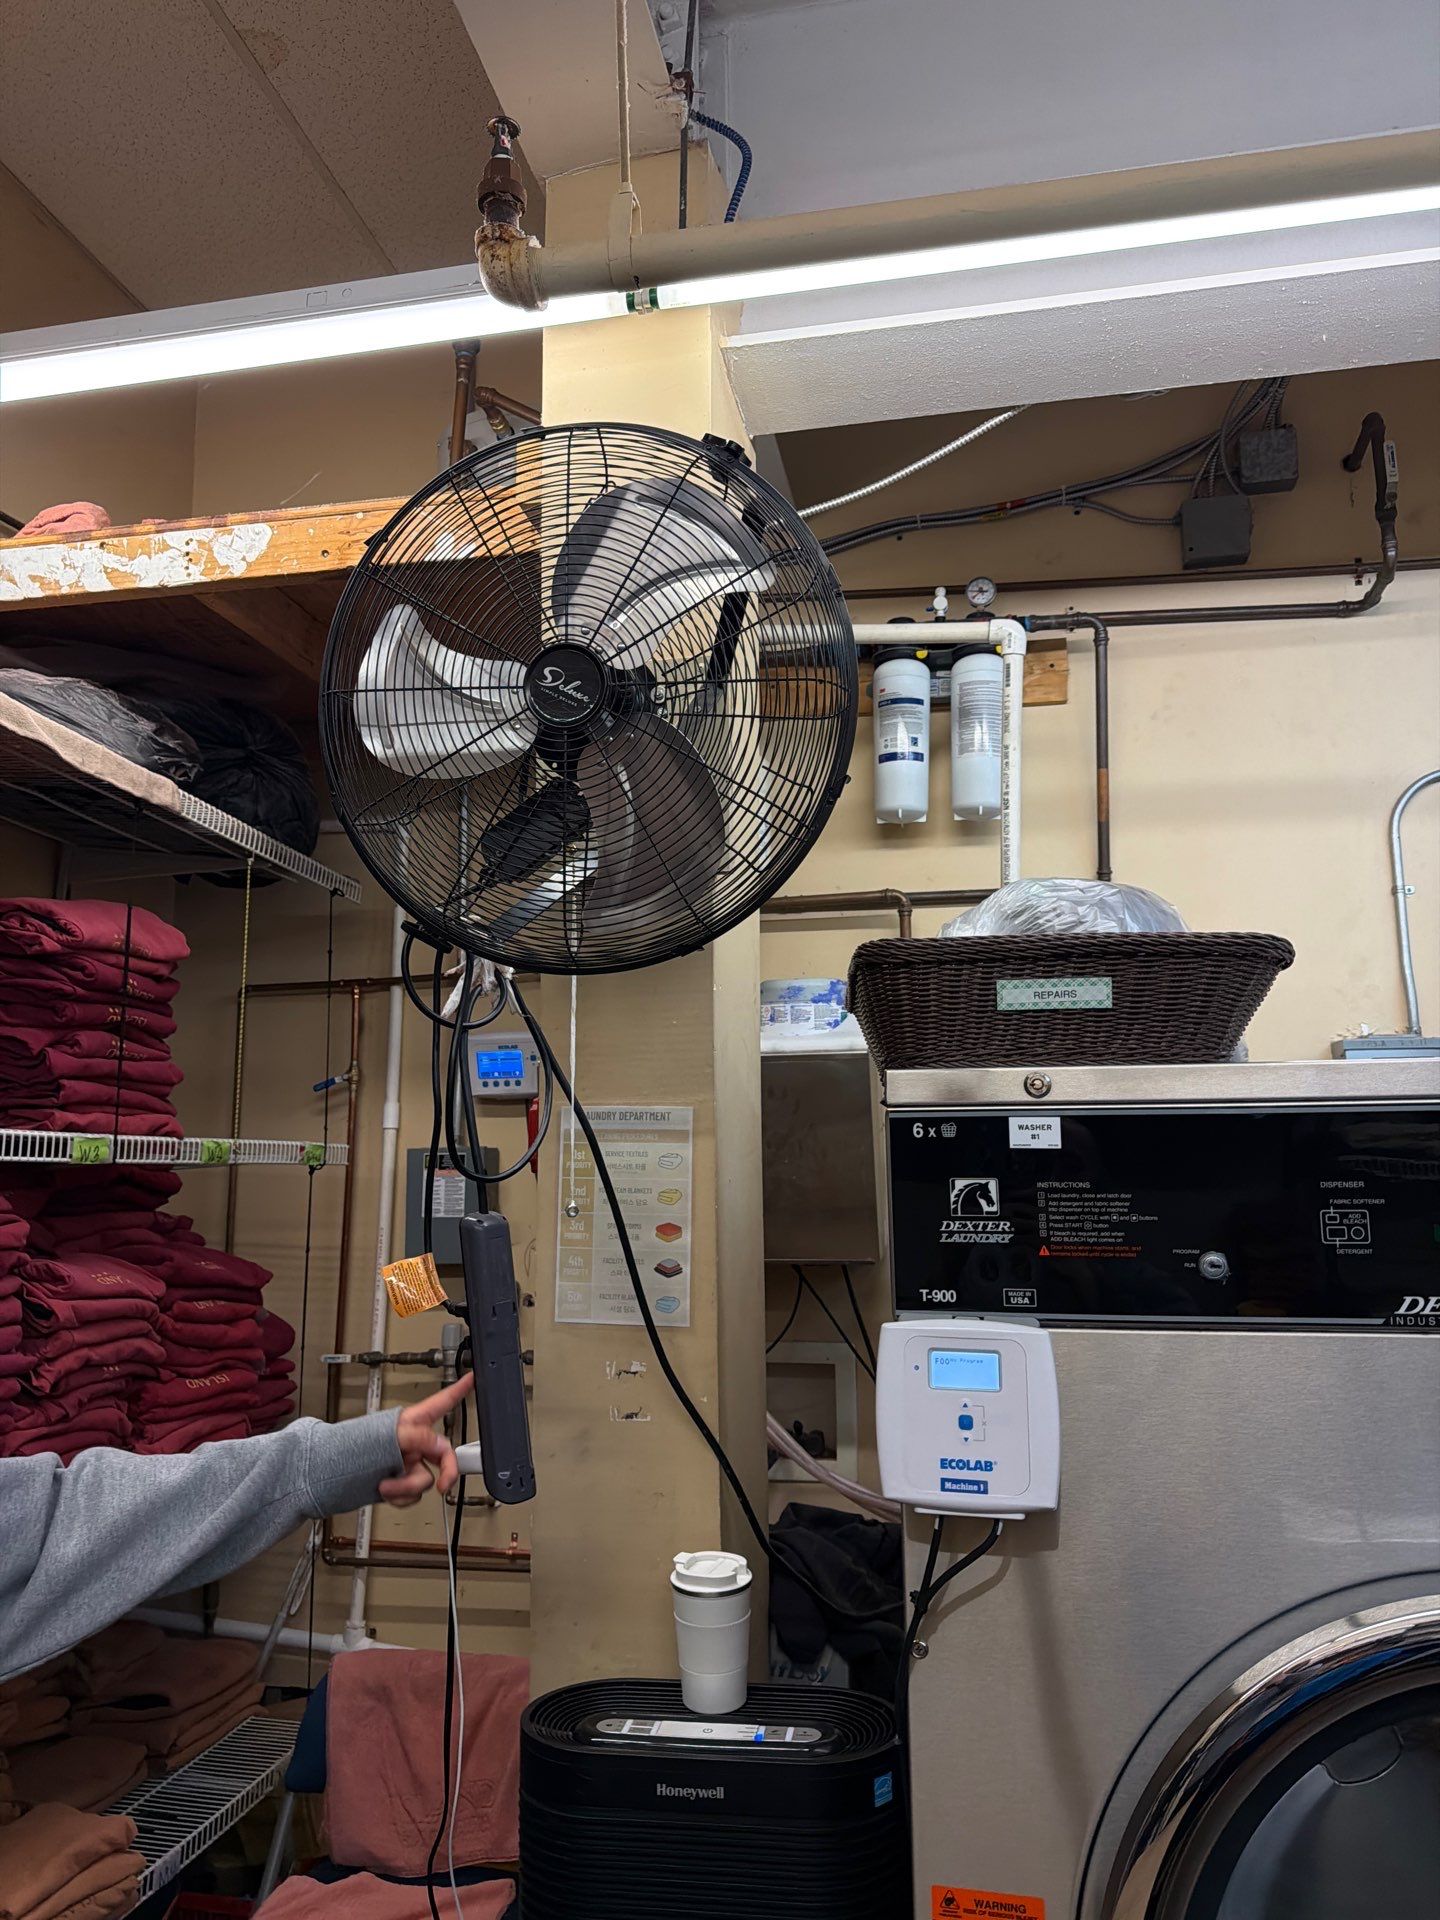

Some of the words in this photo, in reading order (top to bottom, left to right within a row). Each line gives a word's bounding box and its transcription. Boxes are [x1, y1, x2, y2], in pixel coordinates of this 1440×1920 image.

[1033, 990, 1077, 1000] REPAIRS
[586, 1111, 617, 1121] AUNDRY
[619, 1111, 671, 1121] DEPARTMENT
[912, 1122, 924, 1138] 6
[1036, 1181, 1091, 1189] INSTRUCTIONS
[940, 1220, 1010, 1232] DEXTER
[939, 1233, 1014, 1244] LAUNDRY
[919, 1289, 957, 1302] T-900
[185, 1372, 230, 1390] ISLAND
[940, 1458, 994, 1472] ECOLAB
[944, 1481, 979, 1491] Machine
[656, 1783, 725, 1800] Honeywell
[974, 1898, 1027, 1914] WARNING
